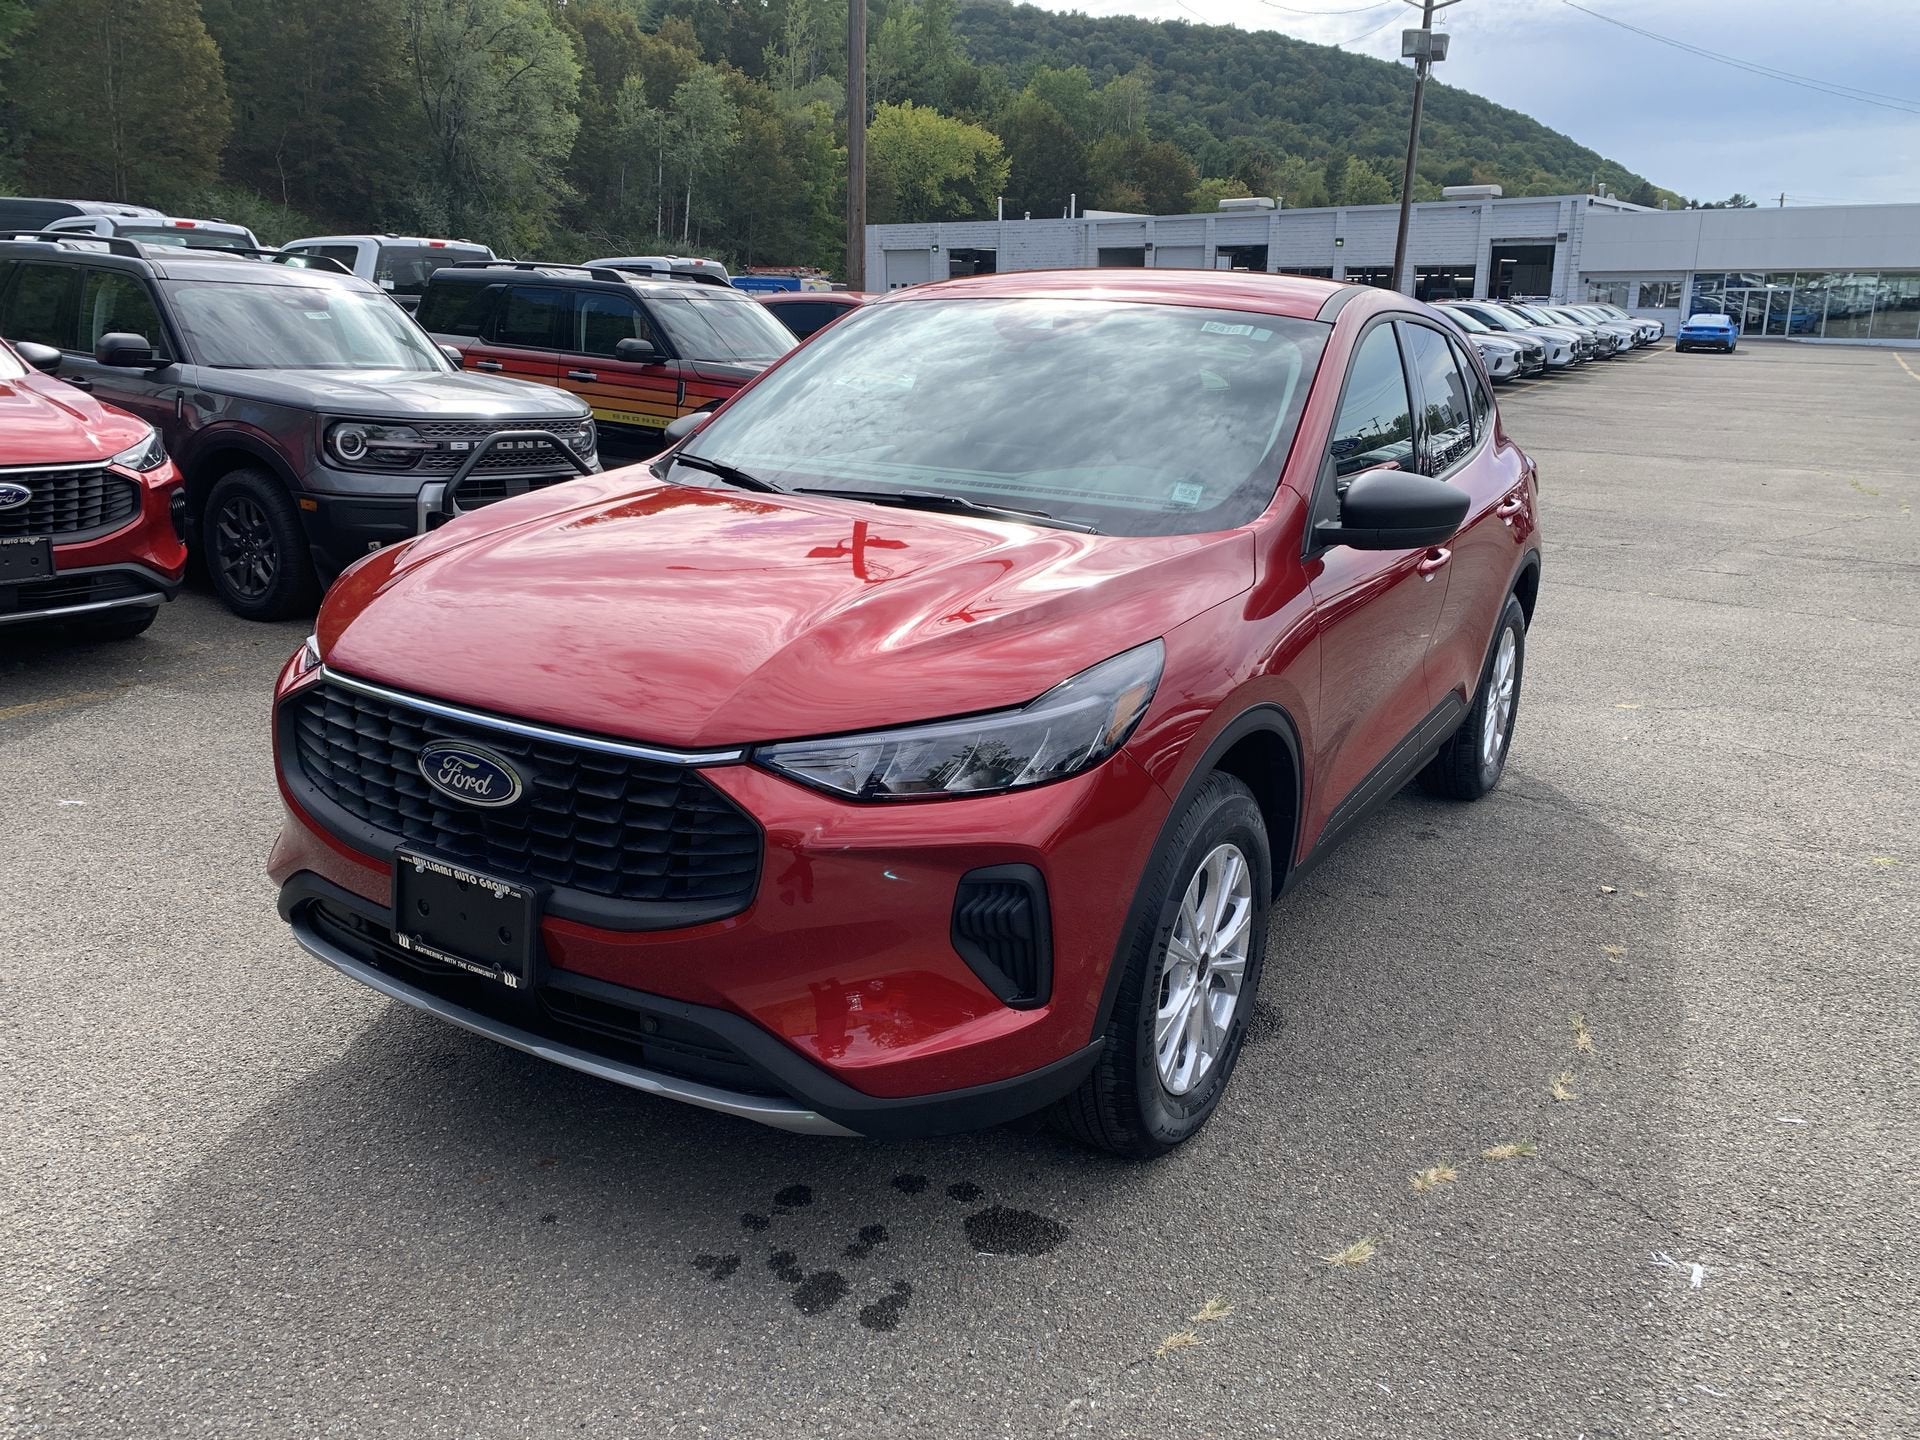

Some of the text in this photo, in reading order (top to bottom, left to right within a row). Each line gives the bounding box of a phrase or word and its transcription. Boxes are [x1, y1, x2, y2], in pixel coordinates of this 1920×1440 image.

[437, 755, 494, 795] Ford
[454, 870, 477, 885] AUTO
[414, 945, 497, 980] PARTNERING WITH THE COMMUNITY
